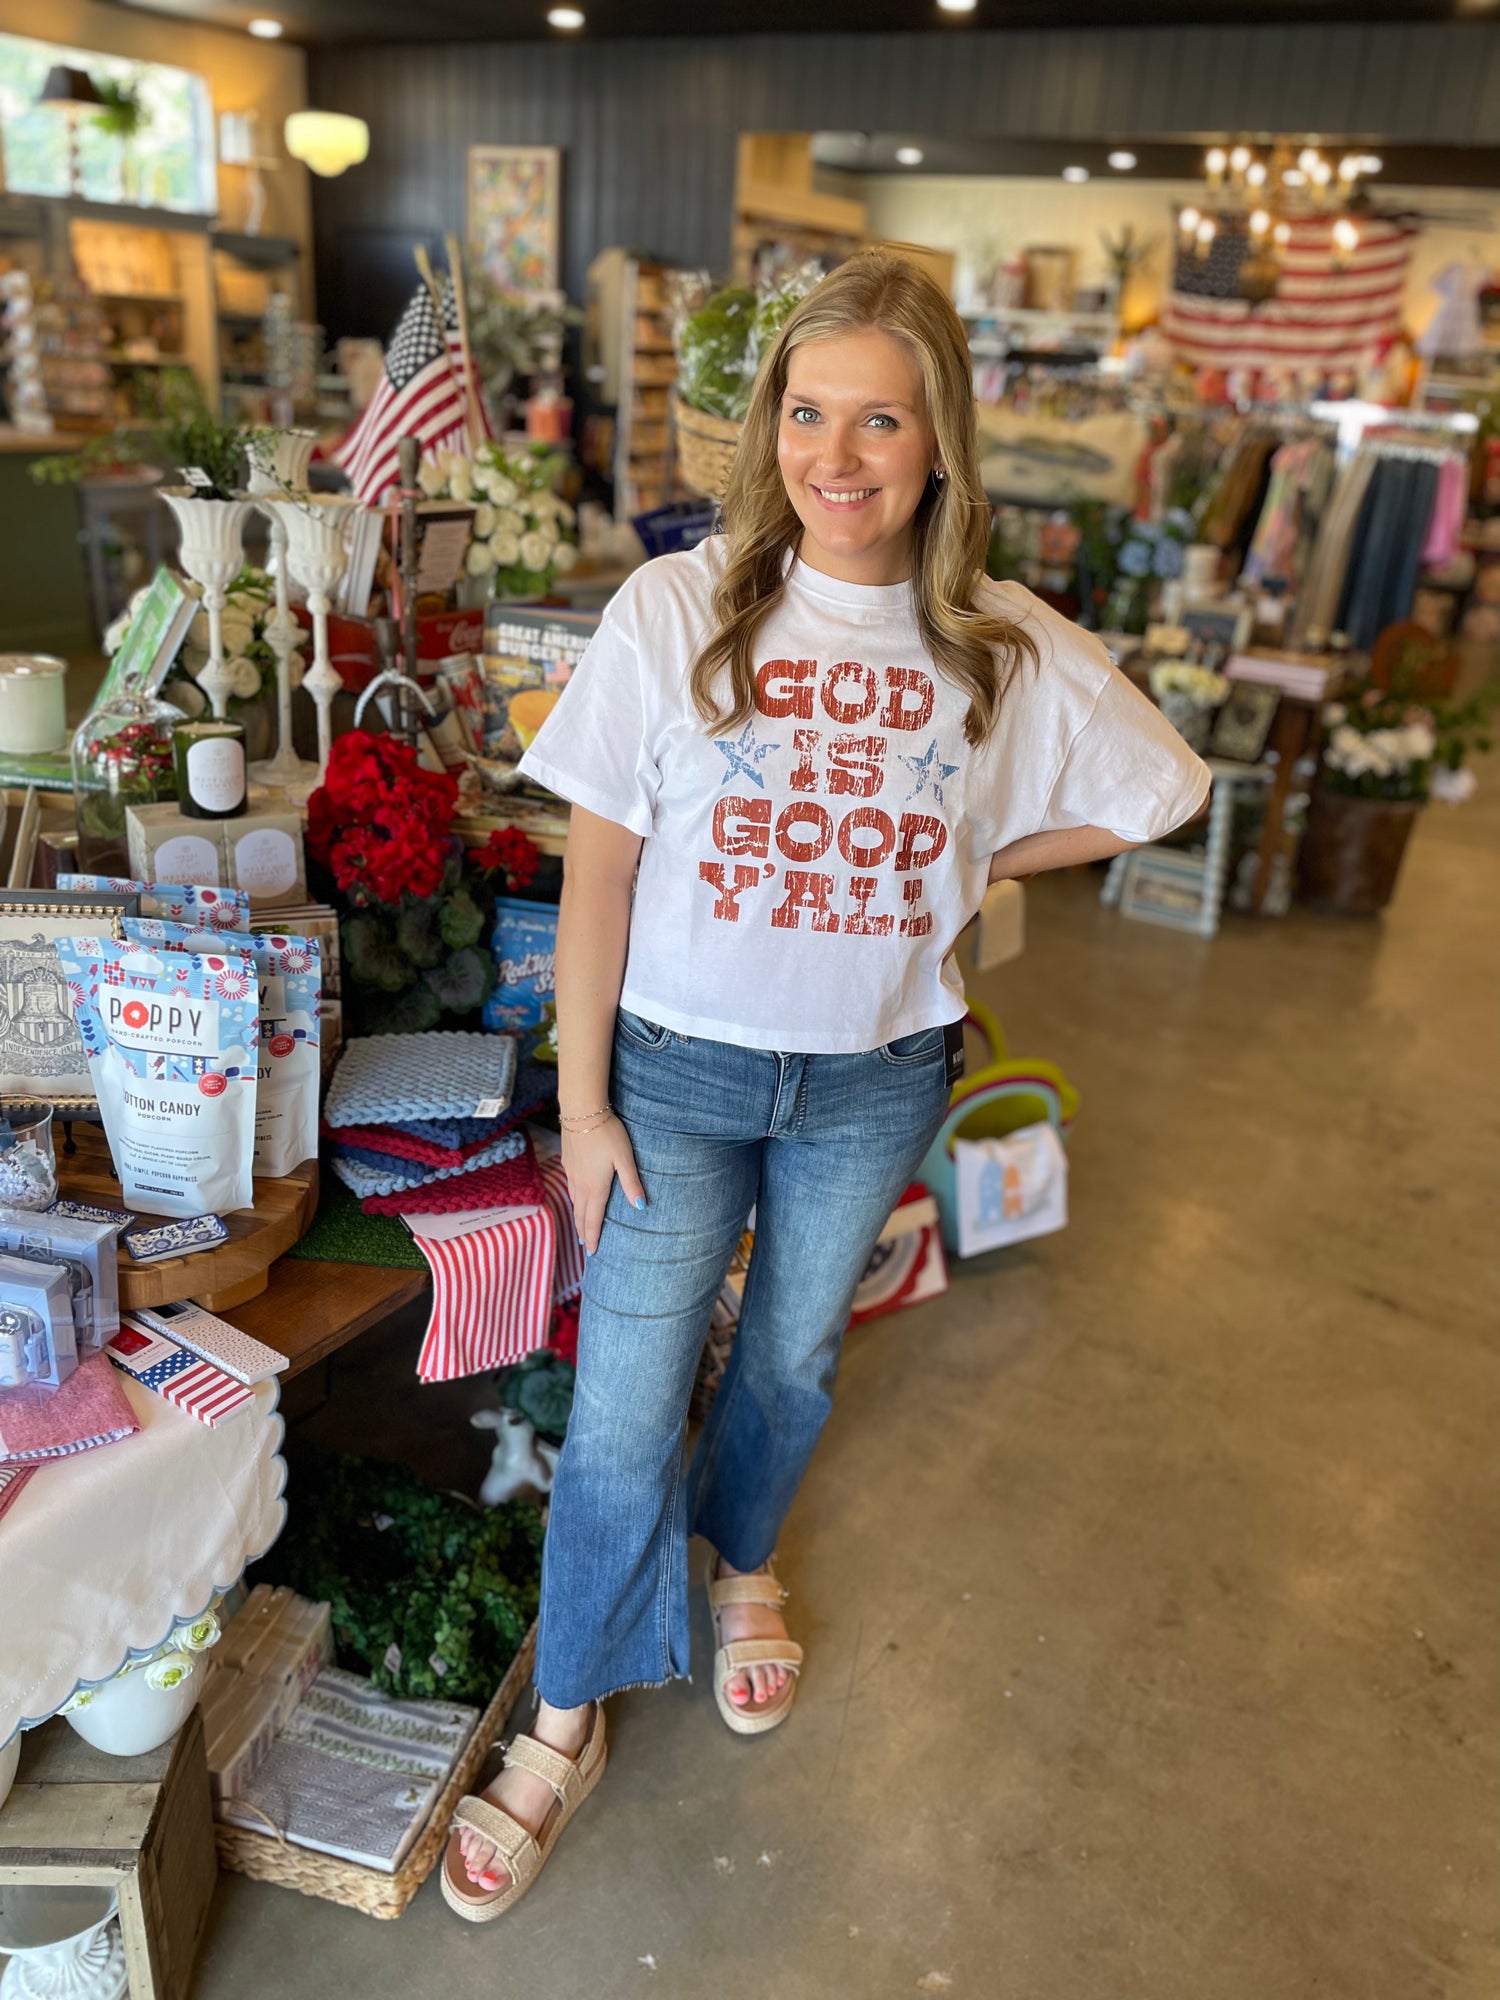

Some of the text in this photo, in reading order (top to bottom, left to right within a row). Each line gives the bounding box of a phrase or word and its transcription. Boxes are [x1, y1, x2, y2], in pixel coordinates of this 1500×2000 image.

[756, 659, 936, 732] GOD
[789, 728, 888, 798] IS
[711, 795, 948, 871] GOOD
[698, 861, 934, 938] Y'ALL
[110, 997, 202, 1037] POPPY
[166, 1037, 203, 1047] POPCORN
[124, 1090, 201, 1117] OTTON CANDY
[137, 1112, 172, 1122] POPCORN
